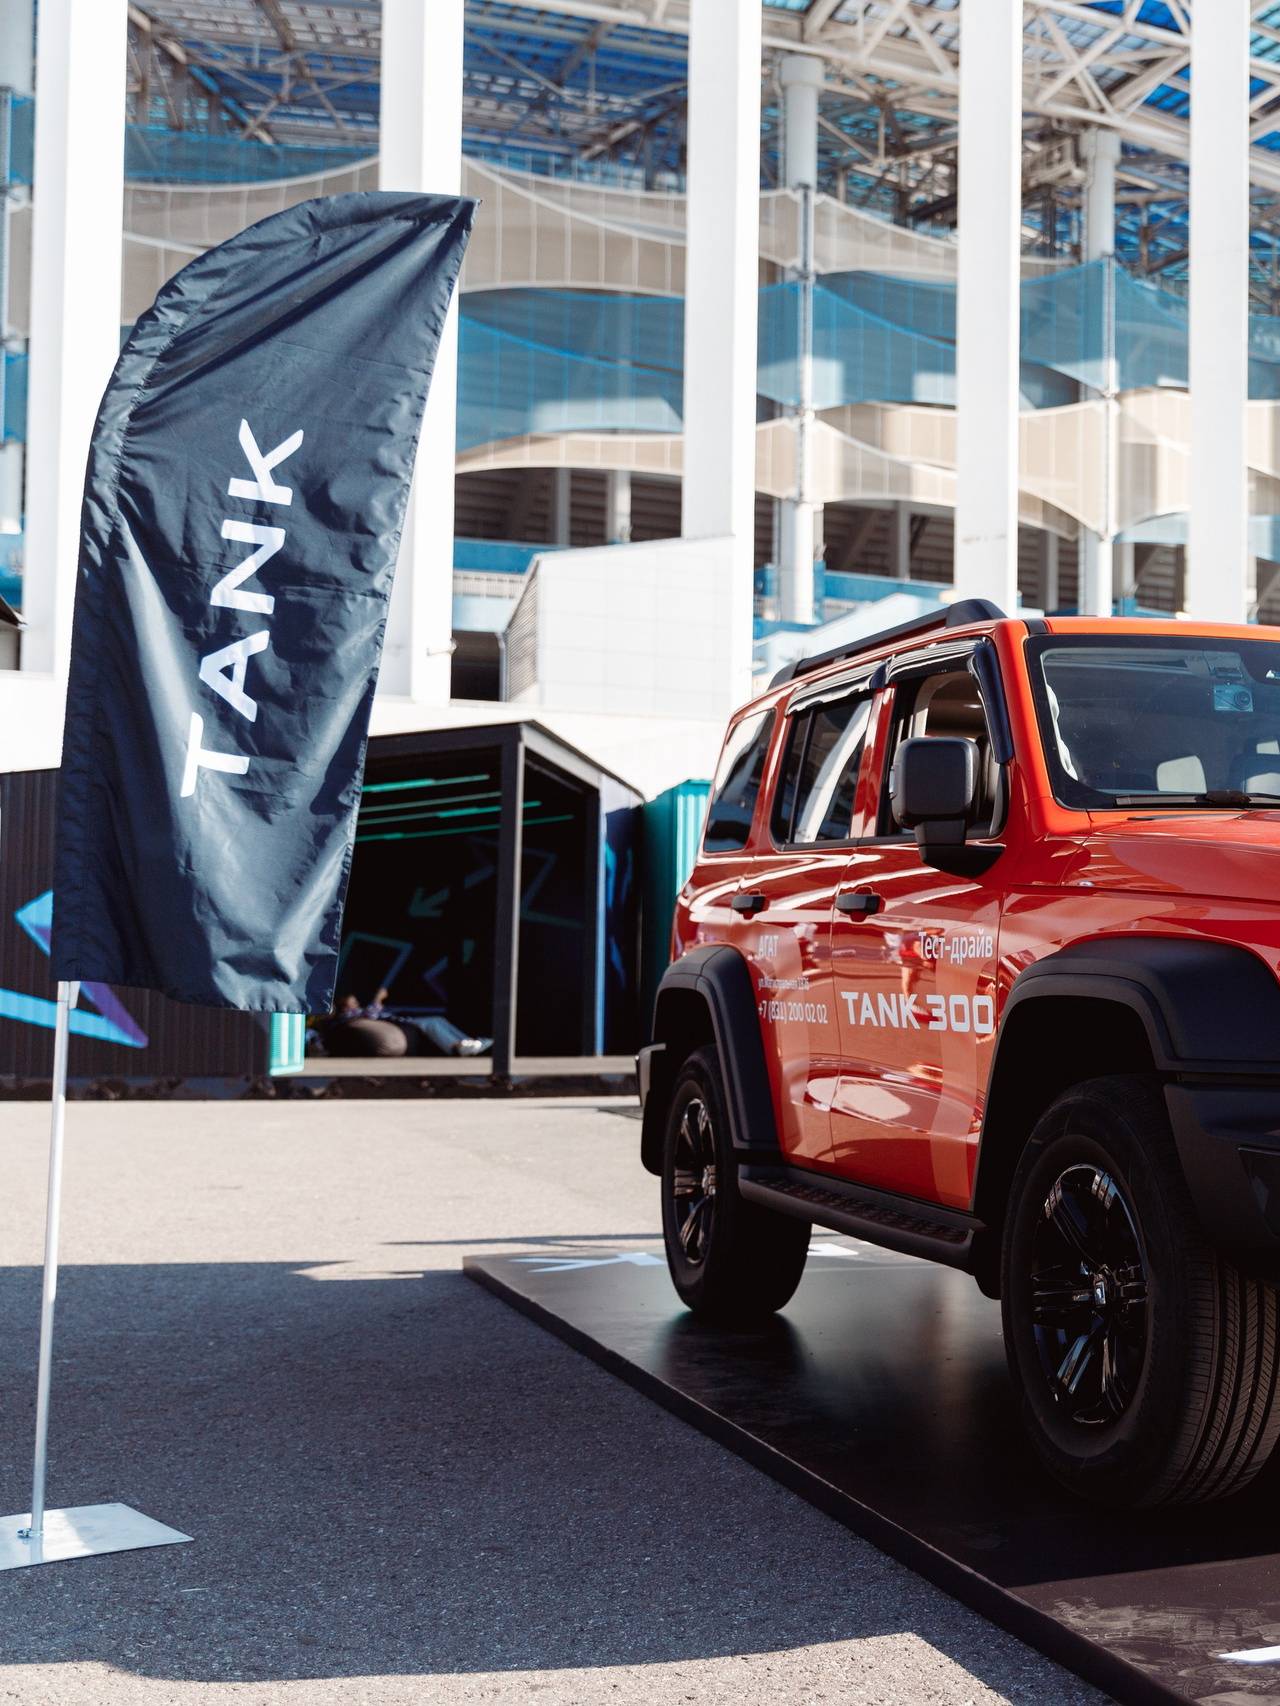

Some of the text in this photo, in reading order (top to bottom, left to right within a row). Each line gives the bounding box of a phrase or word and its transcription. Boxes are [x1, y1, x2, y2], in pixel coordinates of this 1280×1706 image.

[179, 418, 304, 798] TANK
[757, 934, 779, 958] АГАТ
[918, 929, 993, 965] Тест-драйв
[757, 1000, 828, 1024] +7 (831) 200 02 02
[840, 992, 994, 1034] TANK 300
